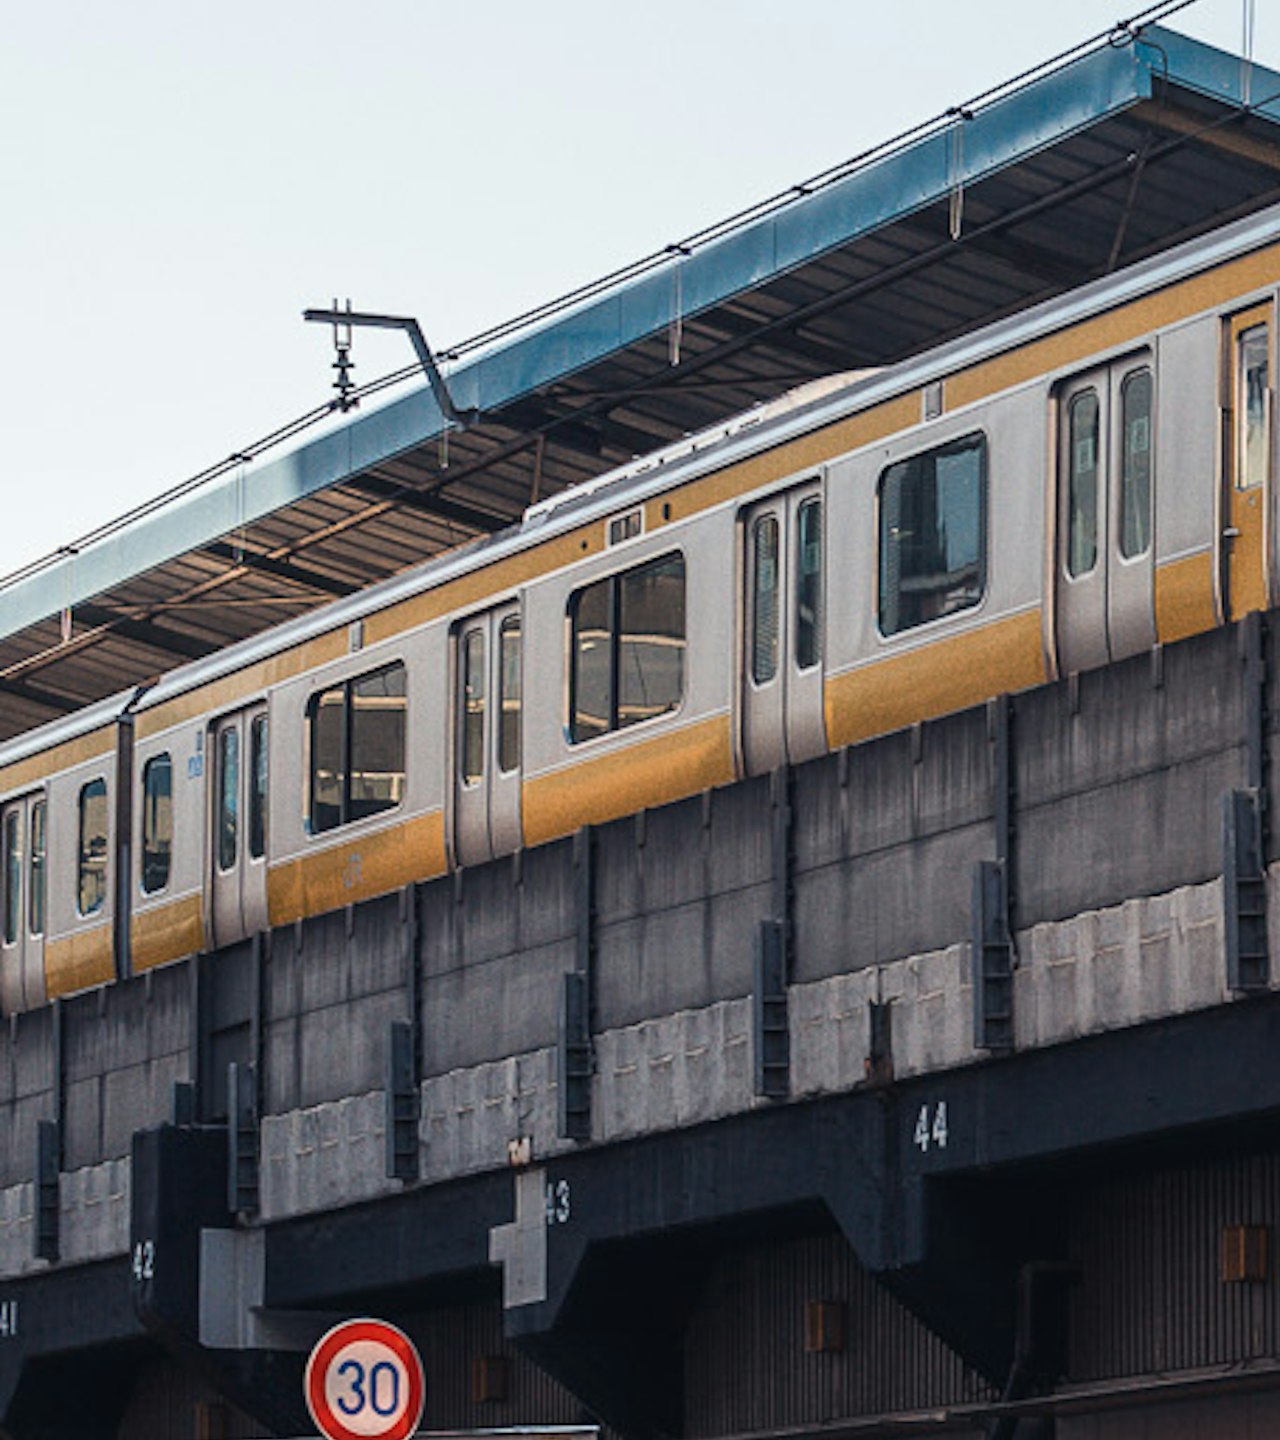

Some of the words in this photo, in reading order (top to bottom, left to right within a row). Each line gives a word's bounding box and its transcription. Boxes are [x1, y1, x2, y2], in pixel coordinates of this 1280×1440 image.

[913, 1100, 948, 1152] 44
[133, 1239, 154, 1281] 42
[337, 1359, 399, 1417] 30
